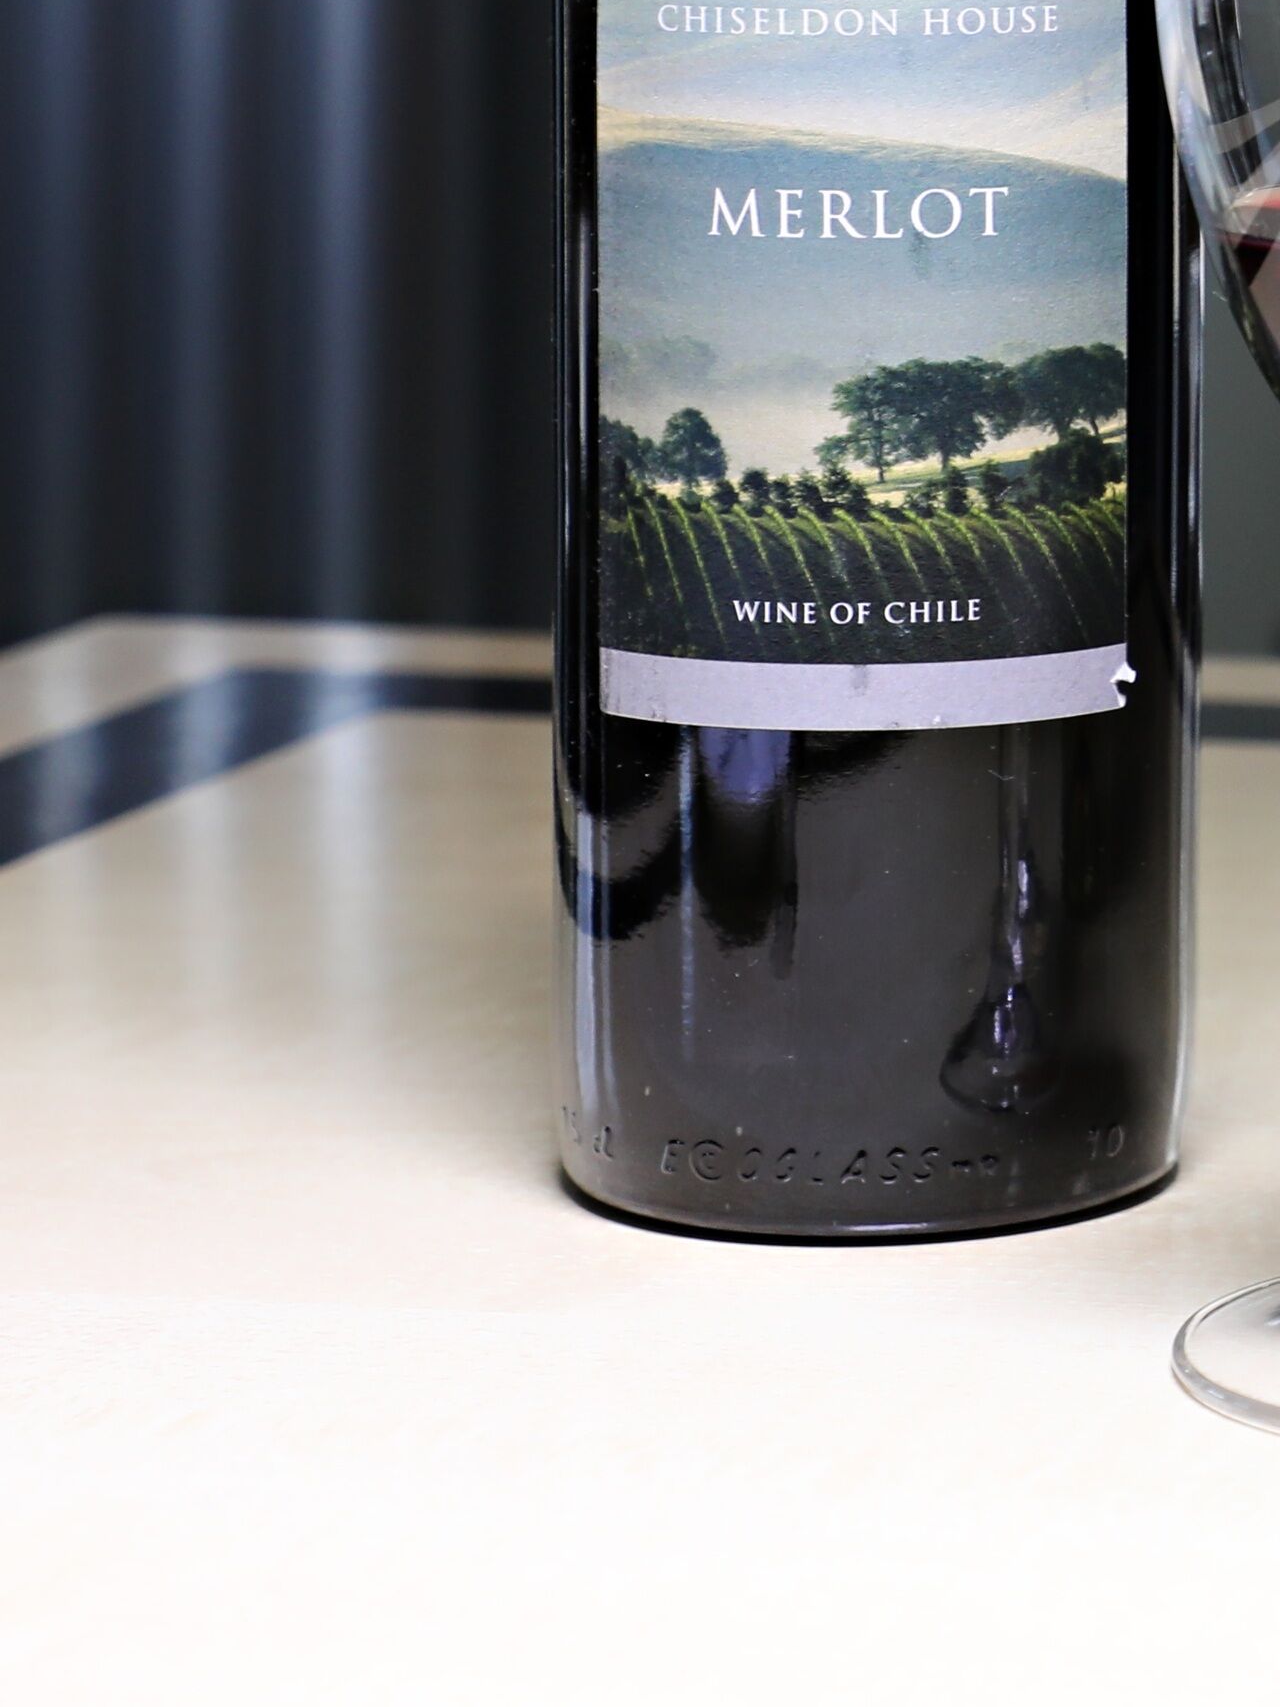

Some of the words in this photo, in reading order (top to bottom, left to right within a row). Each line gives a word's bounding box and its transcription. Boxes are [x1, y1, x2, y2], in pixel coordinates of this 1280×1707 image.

[656, 4, 900, 37] CHISELDON
[922, 4, 1060, 36] HOUSE
[706, 185, 1010, 240] MERLOT
[732, 597, 817, 626] WINE
[829, 600, 873, 626] OF
[883, 597, 982, 625] CHILE
